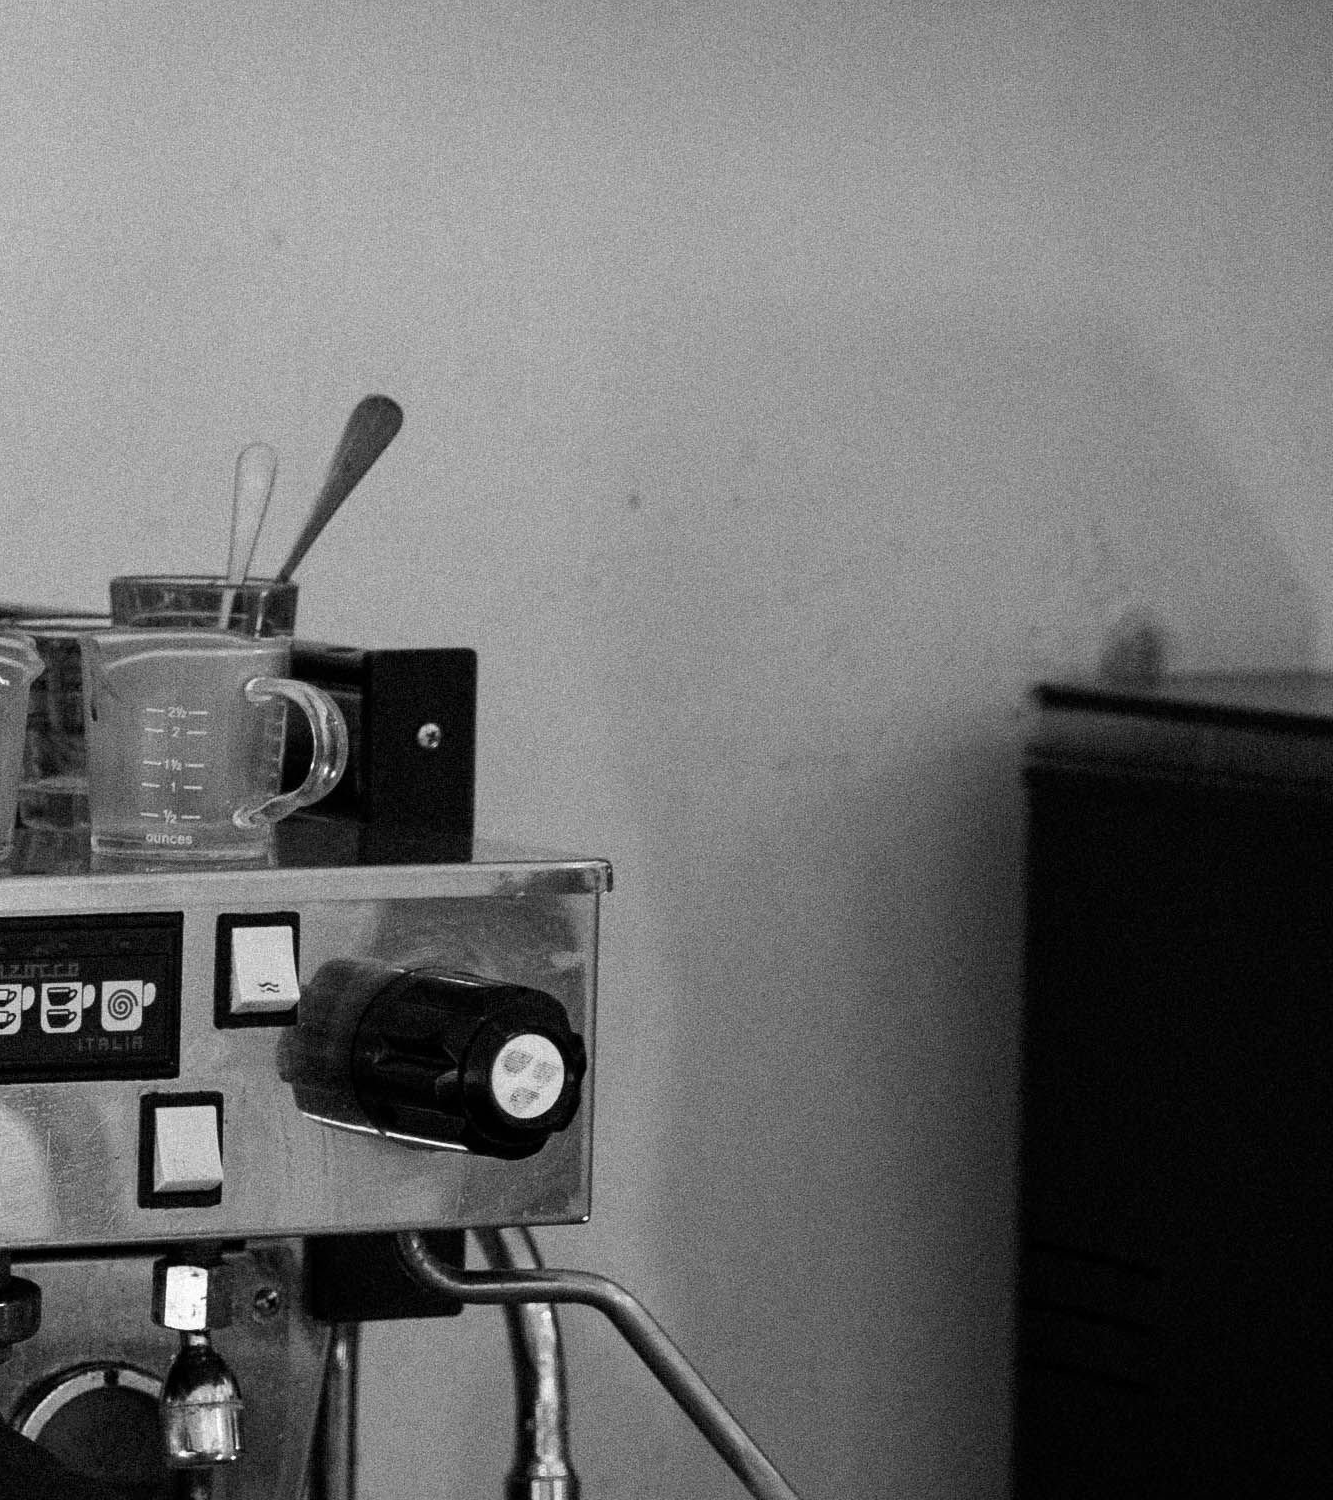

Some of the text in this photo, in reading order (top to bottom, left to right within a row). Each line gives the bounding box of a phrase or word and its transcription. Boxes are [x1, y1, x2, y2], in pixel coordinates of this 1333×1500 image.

[171, 726, 181, 738] 2
[171, 781, 176, 793] 1
[145, 833, 193, 845] ounces
[76, 1035, 144, 1052] ITALIA
